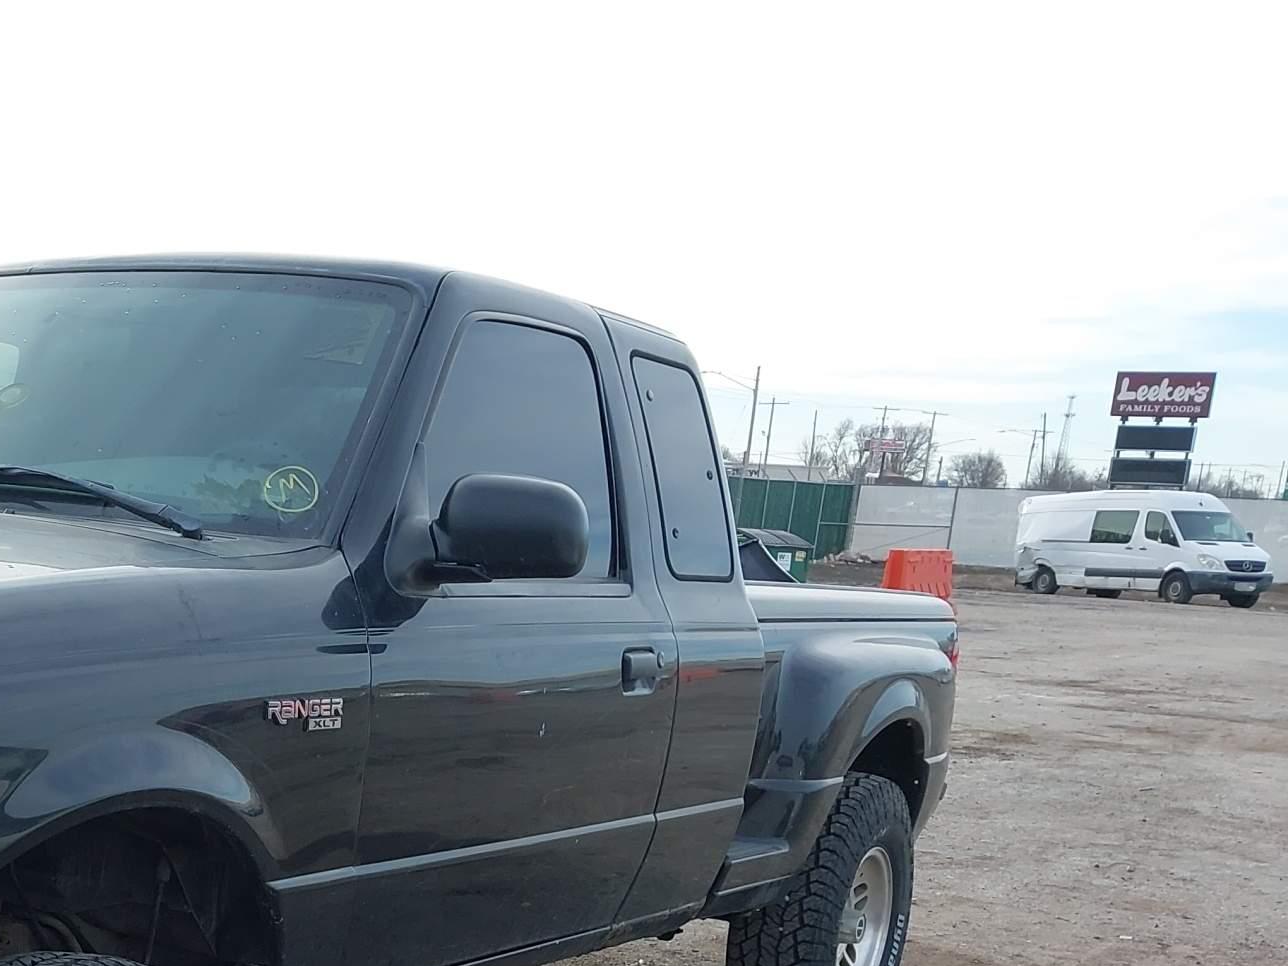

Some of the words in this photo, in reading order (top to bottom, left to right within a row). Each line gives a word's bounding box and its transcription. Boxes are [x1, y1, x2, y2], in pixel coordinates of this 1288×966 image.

[1116, 377, 1210, 403] Leeker's
[1119, 404, 1161, 413] FAMILY
[1163, 405, 1201, 413] FOODS
[312, 719, 338, 729] XLT
